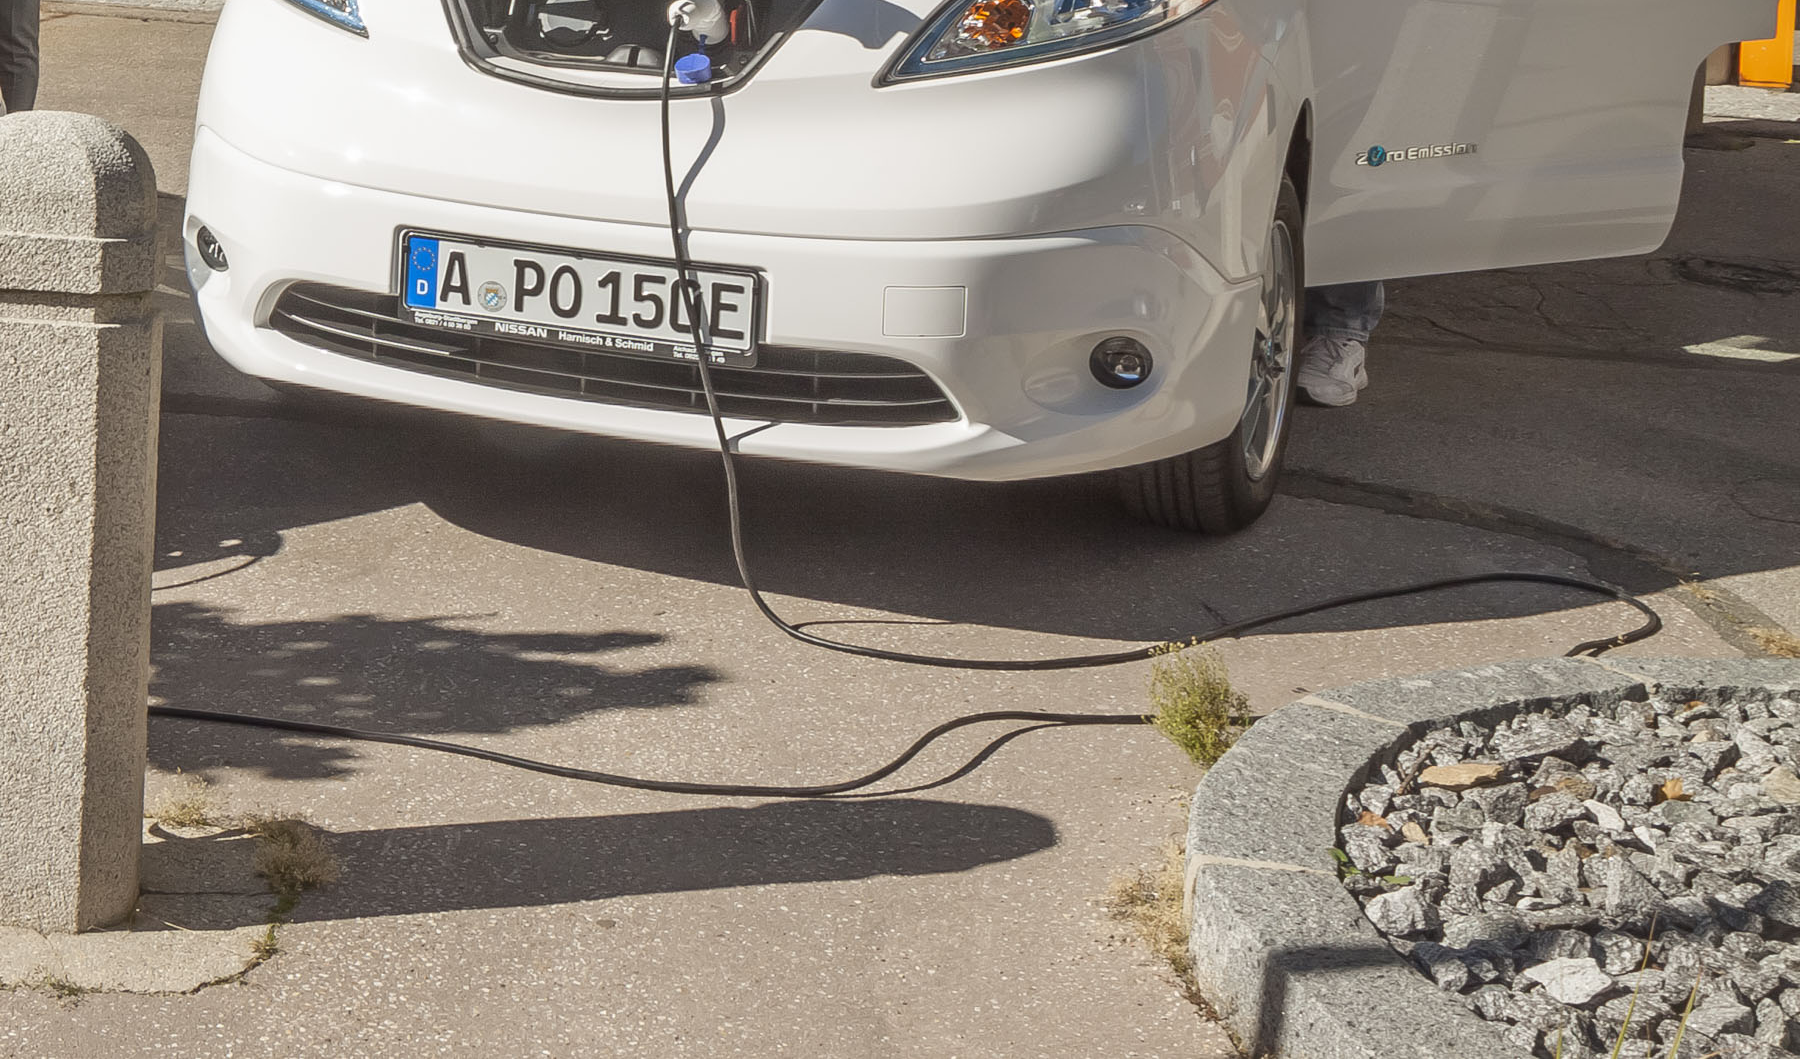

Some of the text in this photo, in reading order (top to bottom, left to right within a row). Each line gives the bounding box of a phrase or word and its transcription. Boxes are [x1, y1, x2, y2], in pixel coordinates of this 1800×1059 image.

[1407, 142, 1479, 161] Emission
[416, 251, 745, 340] D A PO 150E
[494, 322, 654, 352] NISSAN Harnisch & Schmid
